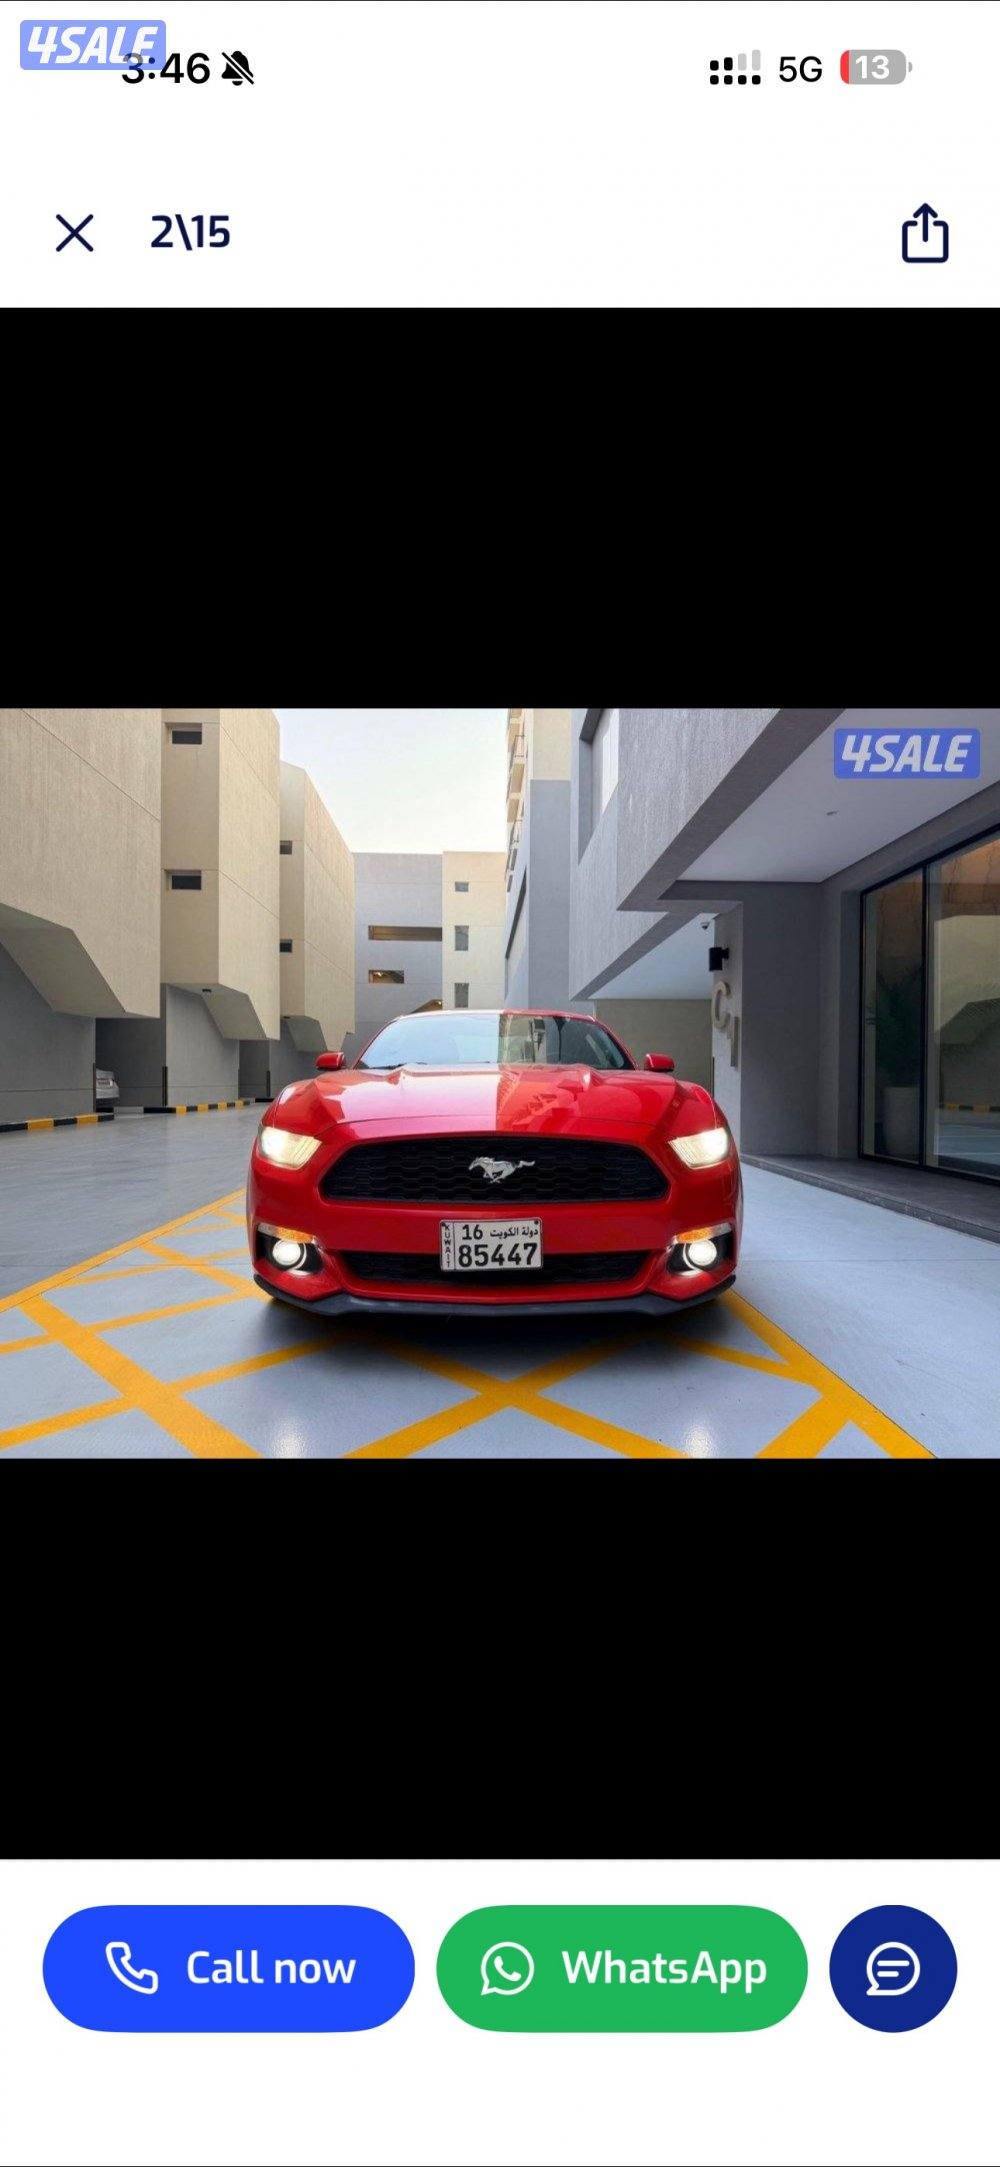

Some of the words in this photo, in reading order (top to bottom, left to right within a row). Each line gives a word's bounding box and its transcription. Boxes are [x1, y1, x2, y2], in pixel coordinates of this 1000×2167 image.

[121, 52, 211, 84] 3:46
[779, 56, 822, 82] 5G
[855, 55, 889, 79] 13
[150, 214, 231, 251] 2\15
[462, 1224, 483, 1240] 16
[490, 1226, 519, 1239] الكويت
[521, 1226, 539, 1238] دولة
[458, 1242, 538, 1268] 85447
[186, 1950, 263, 1985] Call
[273, 1957, 356, 1985] now
[562, 1950, 768, 1995] WhatsApp
